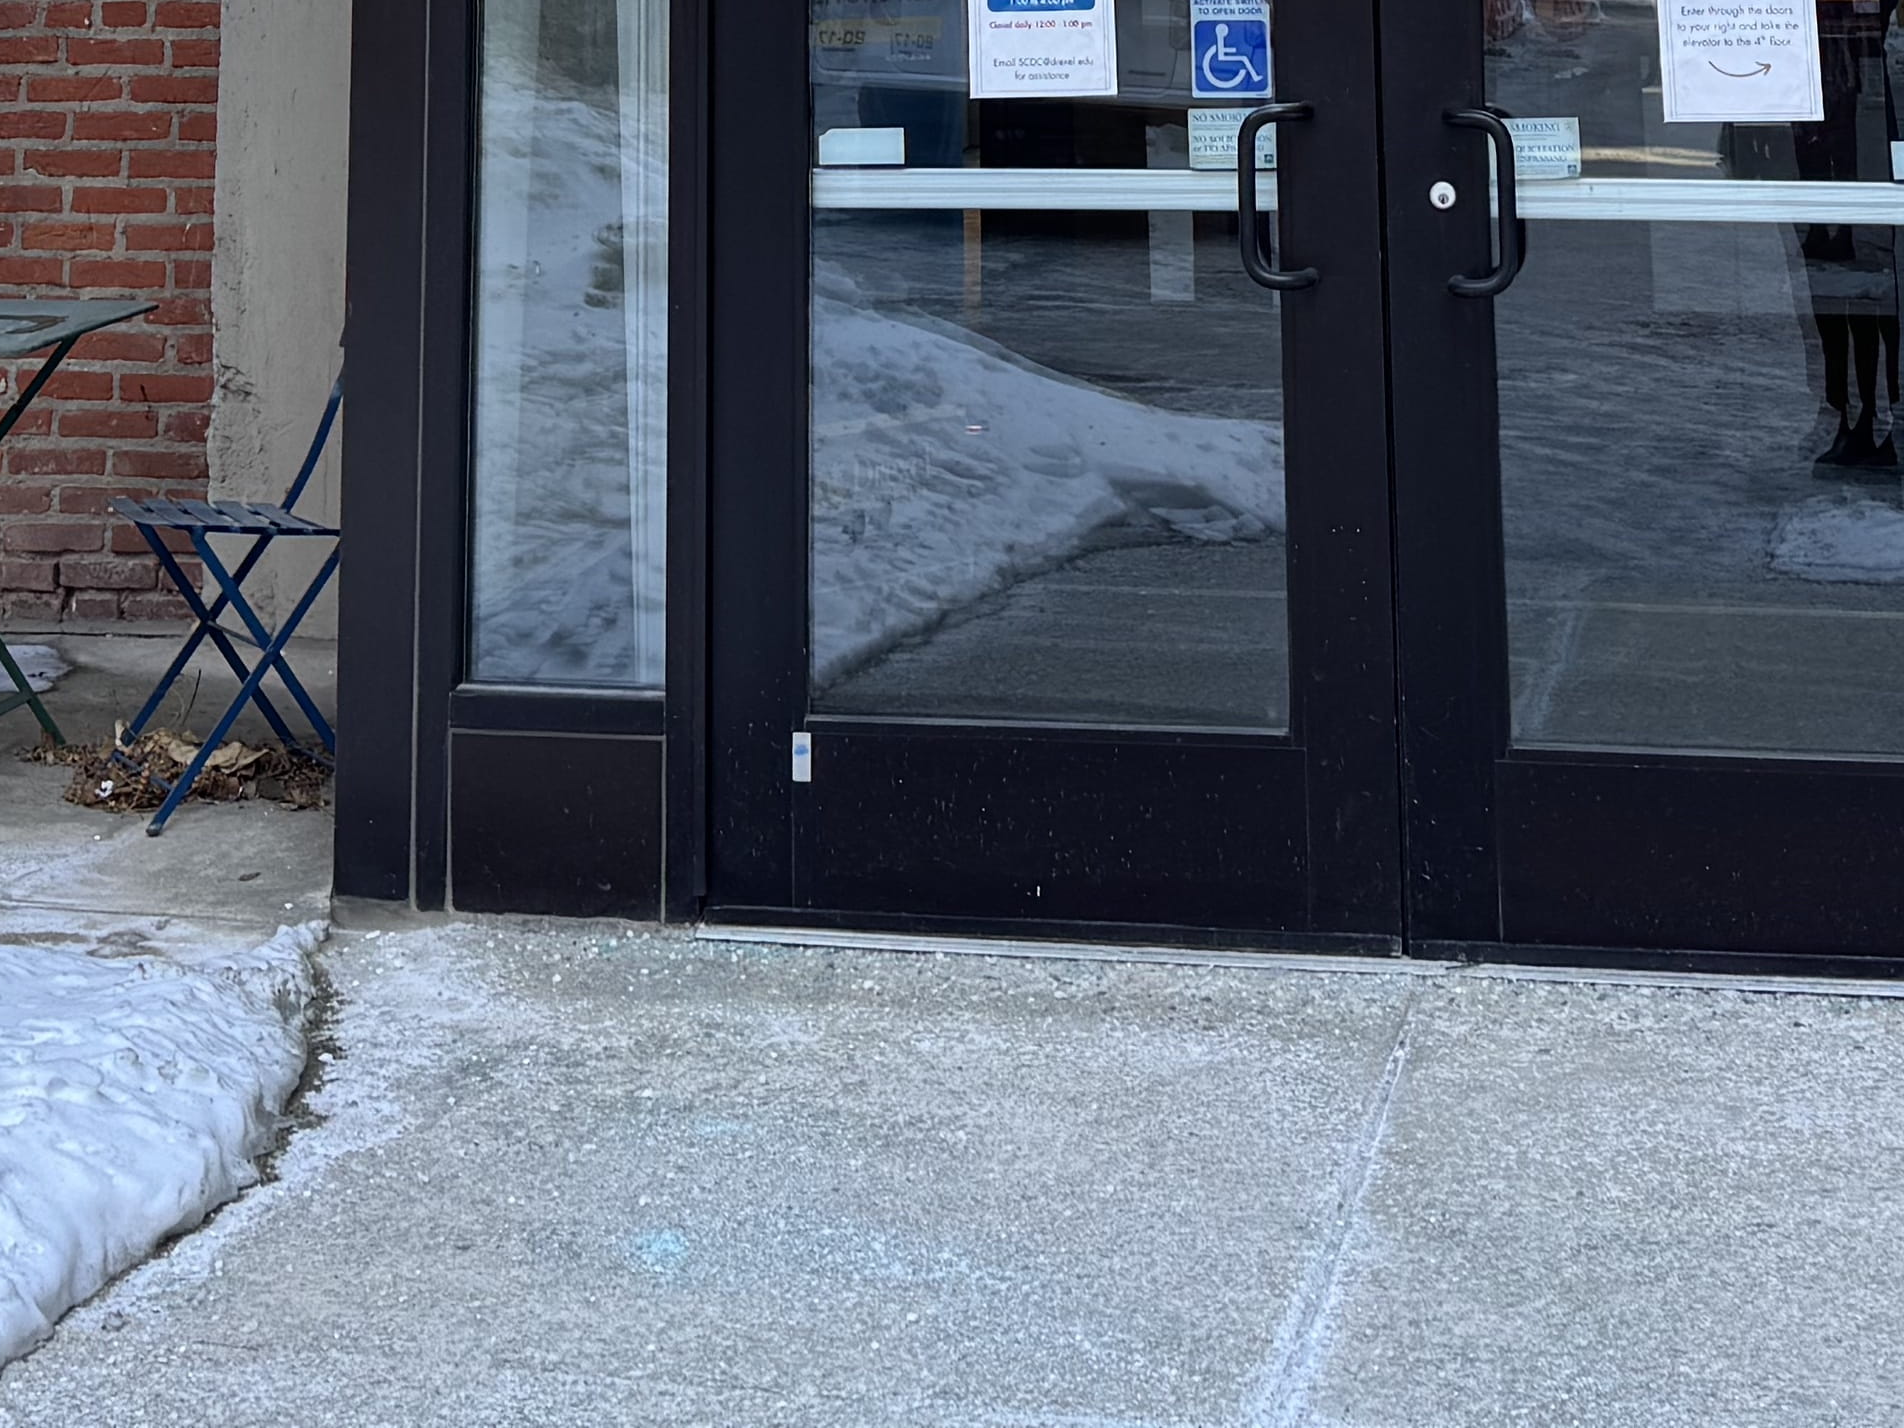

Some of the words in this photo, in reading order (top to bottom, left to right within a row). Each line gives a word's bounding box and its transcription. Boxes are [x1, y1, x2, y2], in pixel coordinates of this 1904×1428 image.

[1198, 7, 1210, 16] TO
[1211, 7, 1236, 16] OPEN
[1238, 6, 1263, 15] DOOR
[1680, 5, 1705, 17] Enter
[1707, 4, 1745, 19] through
[1747, 5, 1763, 15] the
[1765, 4, 1794, 15] doors
[989, 20, 1013, 30] Closed
[1014, 20, 1032, 30] daily
[1035, 19, 1056, 29] 12:00
[1081, 21, 1093, 30] pm
[1676, 21, 1686, 32] to
[1689, 23, 1711, 34] your
[1713, 20, 1736, 34] right
[1738, 20, 1757, 31] and
[1760, 19, 1781, 31] take
[1784, 19, 1800, 31] the
[1682, 38, 1721, 47] elevator
[1723, 38, 1733, 47] to
[1736, 37, 1752, 47] the
[993, 57, 1016, 68] Email
[1014, 70, 1026, 81] for
[1029, 71, 1070, 81] assistance
[1192, 112, 1208, 123] NO
